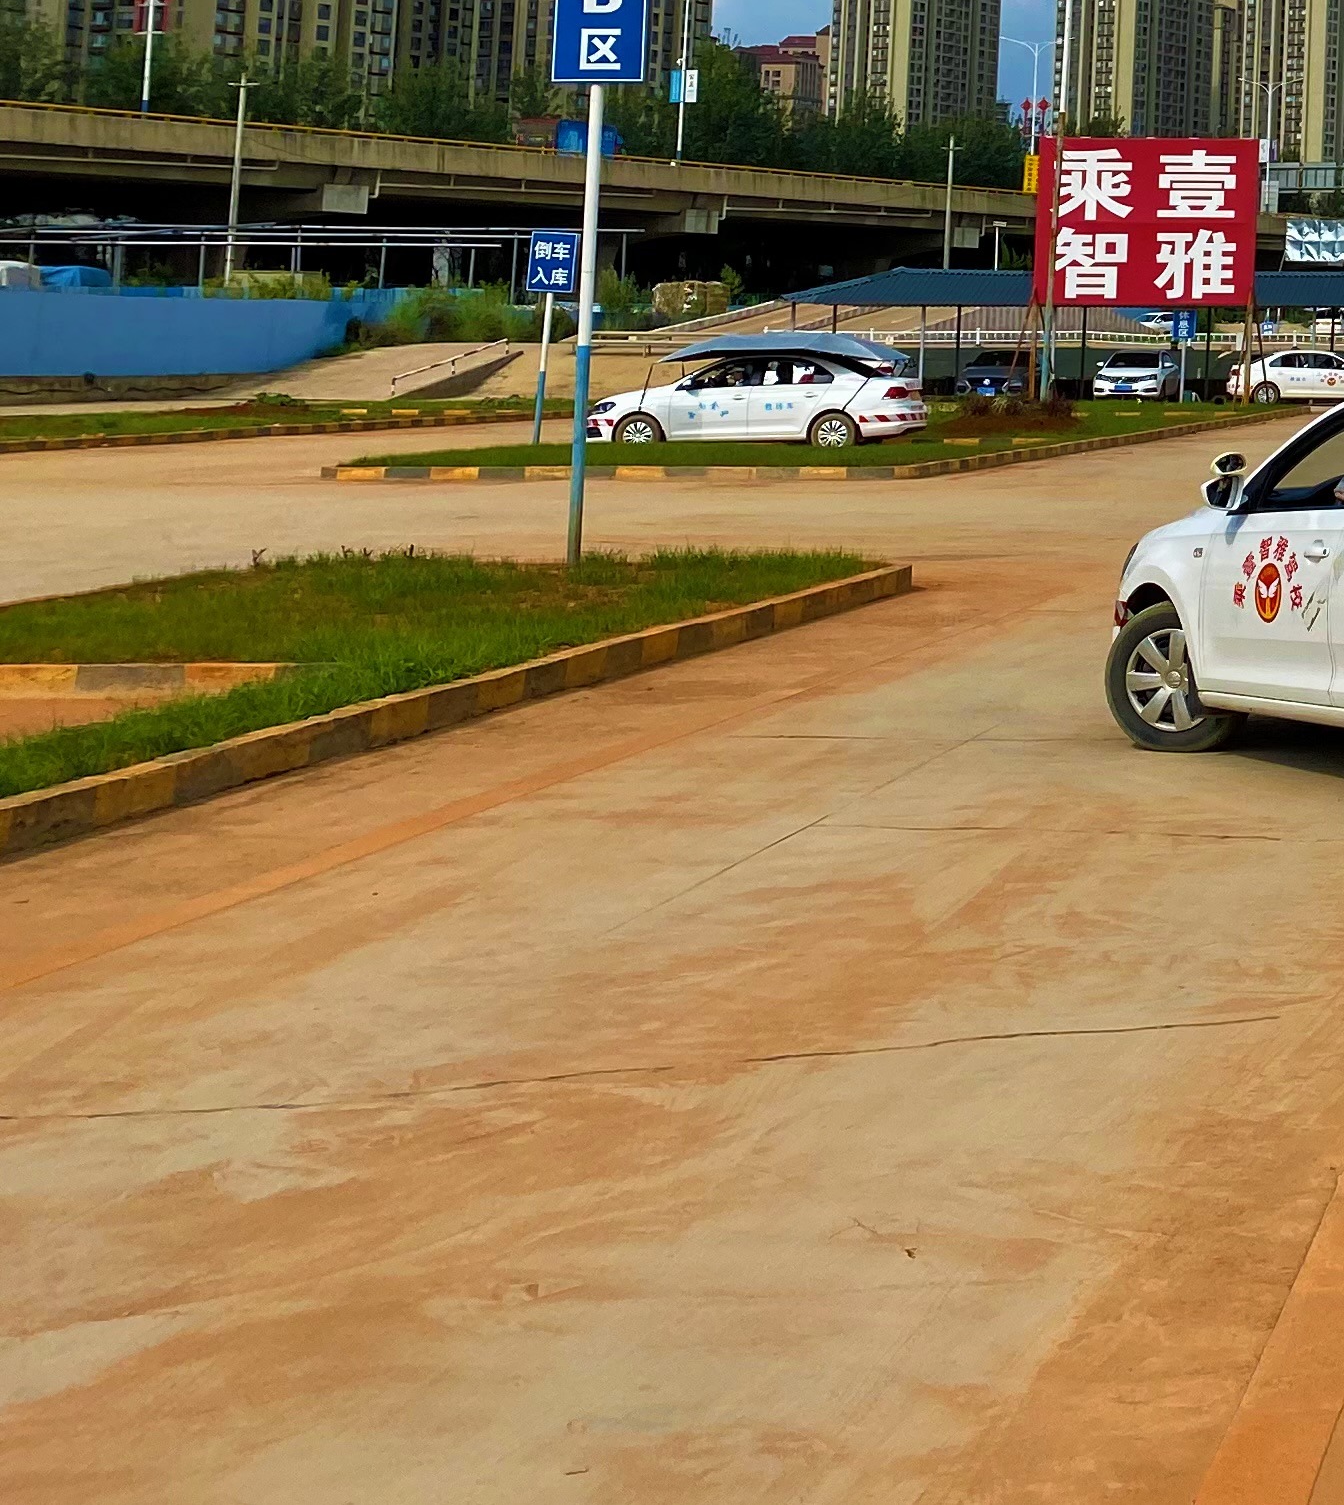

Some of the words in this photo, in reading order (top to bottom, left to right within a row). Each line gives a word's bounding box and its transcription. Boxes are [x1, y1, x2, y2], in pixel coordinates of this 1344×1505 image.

[579, 28, 622, 70] 区
[534, 241, 571, 261] 倒车
[531, 267, 569, 286] 入库
[1177, 310, 1190, 338] 休息区
